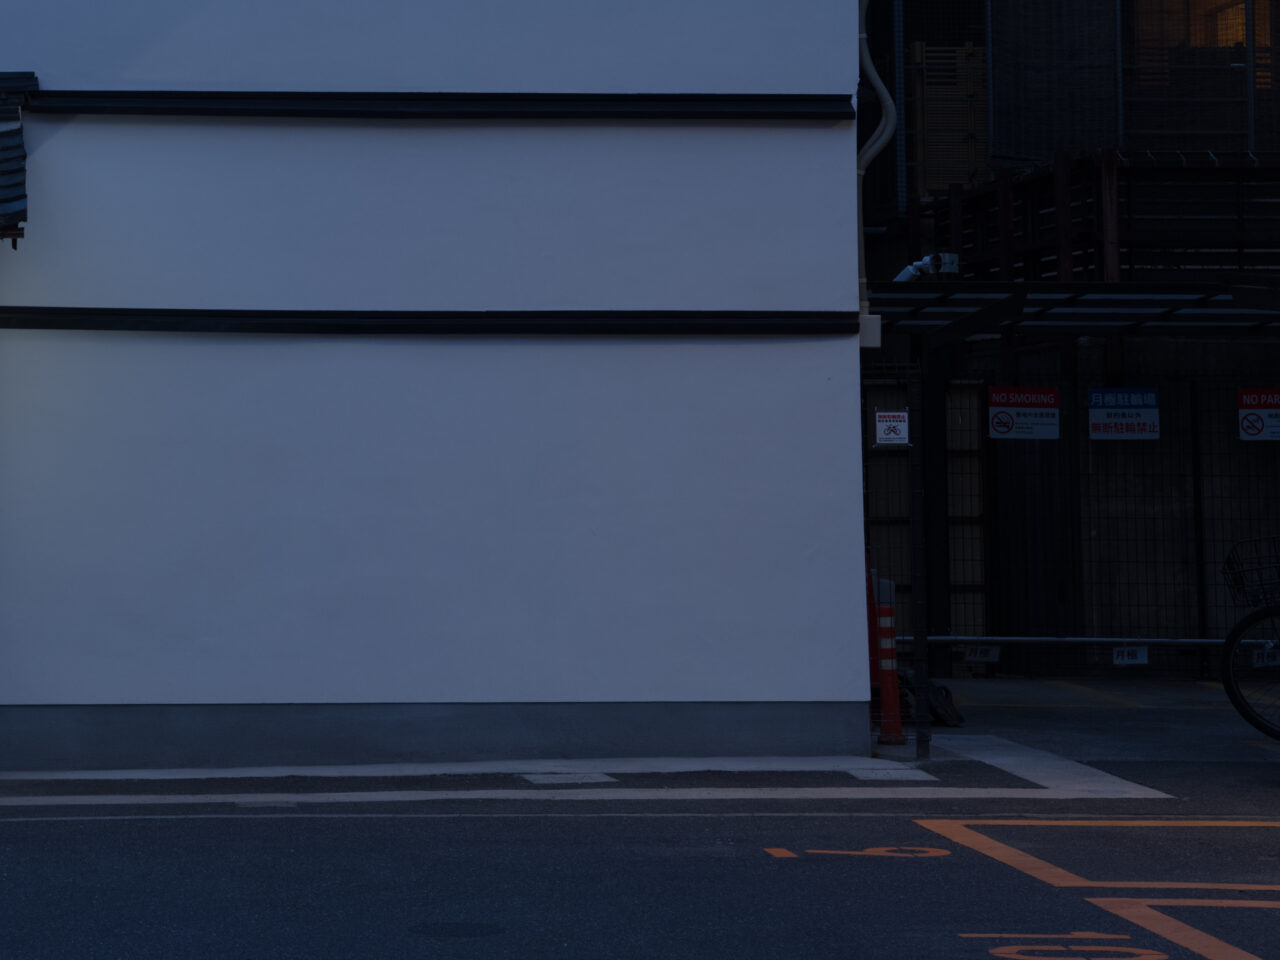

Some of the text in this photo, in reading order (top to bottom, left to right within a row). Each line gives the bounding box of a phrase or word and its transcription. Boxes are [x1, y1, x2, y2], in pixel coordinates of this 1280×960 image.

[992, 392, 1056, 404] NO SMOKING
[1242, 393, 1259, 405] NO
